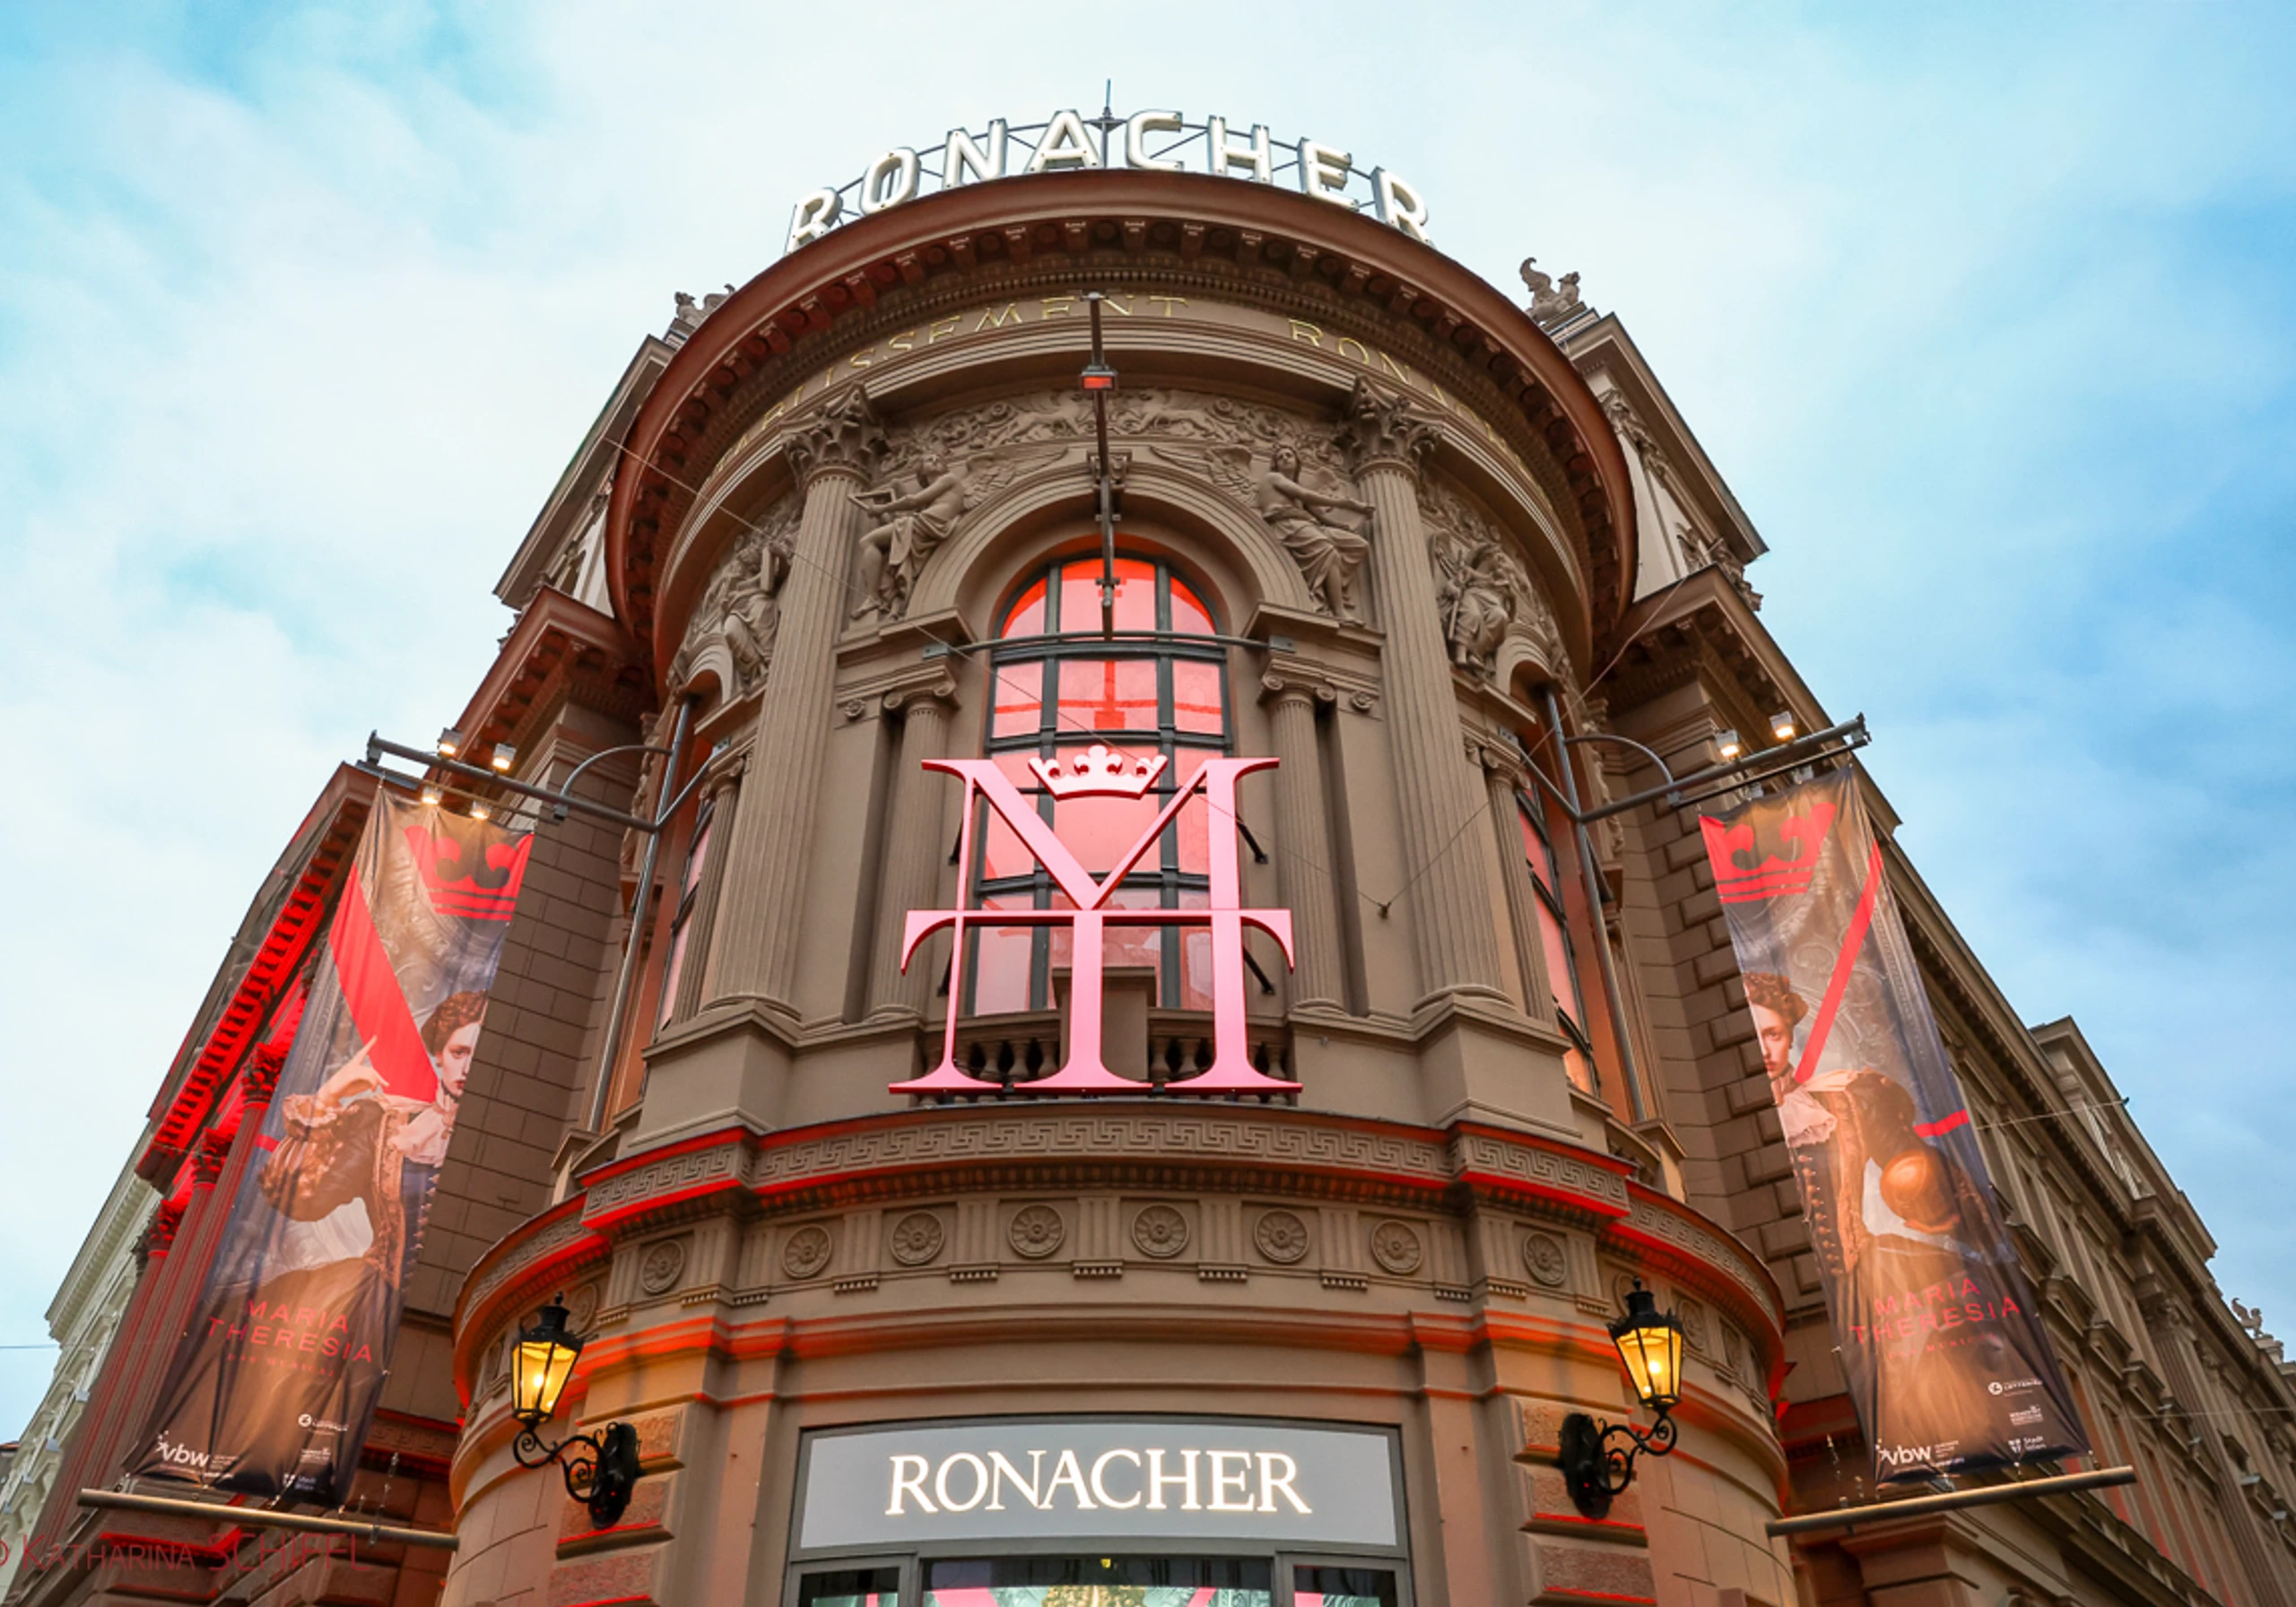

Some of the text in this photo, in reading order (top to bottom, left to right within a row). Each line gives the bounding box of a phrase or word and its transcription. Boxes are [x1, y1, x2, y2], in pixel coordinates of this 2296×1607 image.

[786, 109, 1432, 255] RONACHER
[246, 1299, 349, 1334] MARIA
[1849, 1296, 2020, 1344] THERESIA
[1874, 1277, 1981, 1318] MARIA
[208, 1316, 372, 1363] THERESIA
[884, 1449, 1312, 1516] RONACHER
